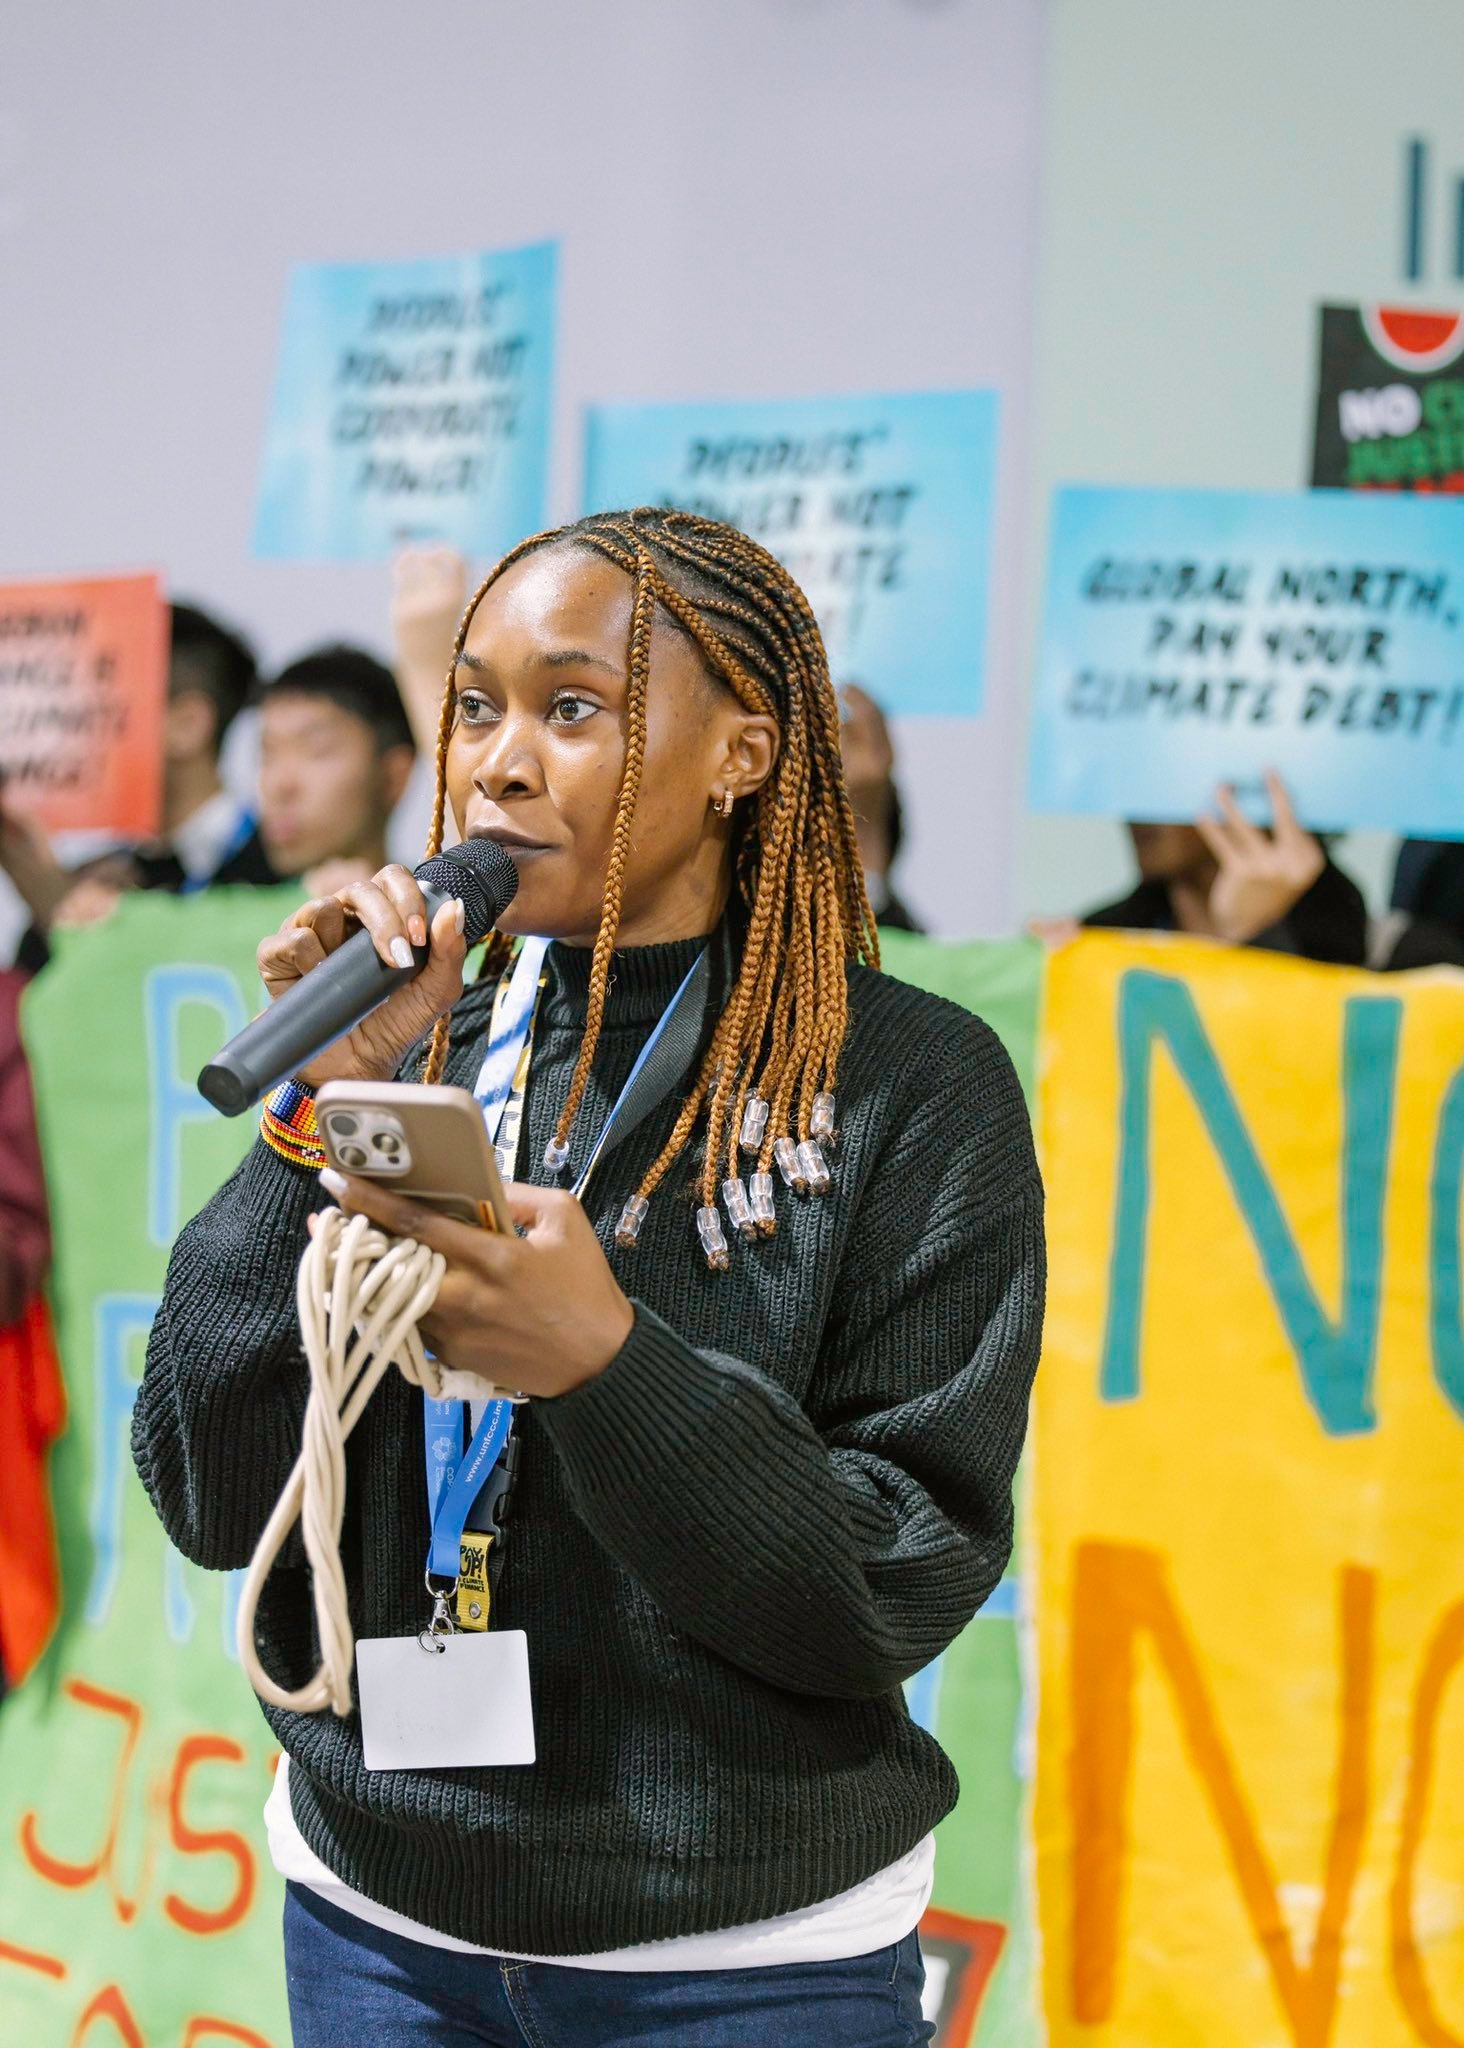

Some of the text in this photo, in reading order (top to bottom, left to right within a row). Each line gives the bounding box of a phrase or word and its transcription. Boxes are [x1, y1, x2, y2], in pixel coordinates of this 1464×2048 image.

[1338, 383, 1423, 443] NO
[1081, 557, 1249, 605] GLOBAL
[1147, 614, 1388, 668] PAY YOUR
[1067, 668, 1464, 746] CLIMATE DEBT!
